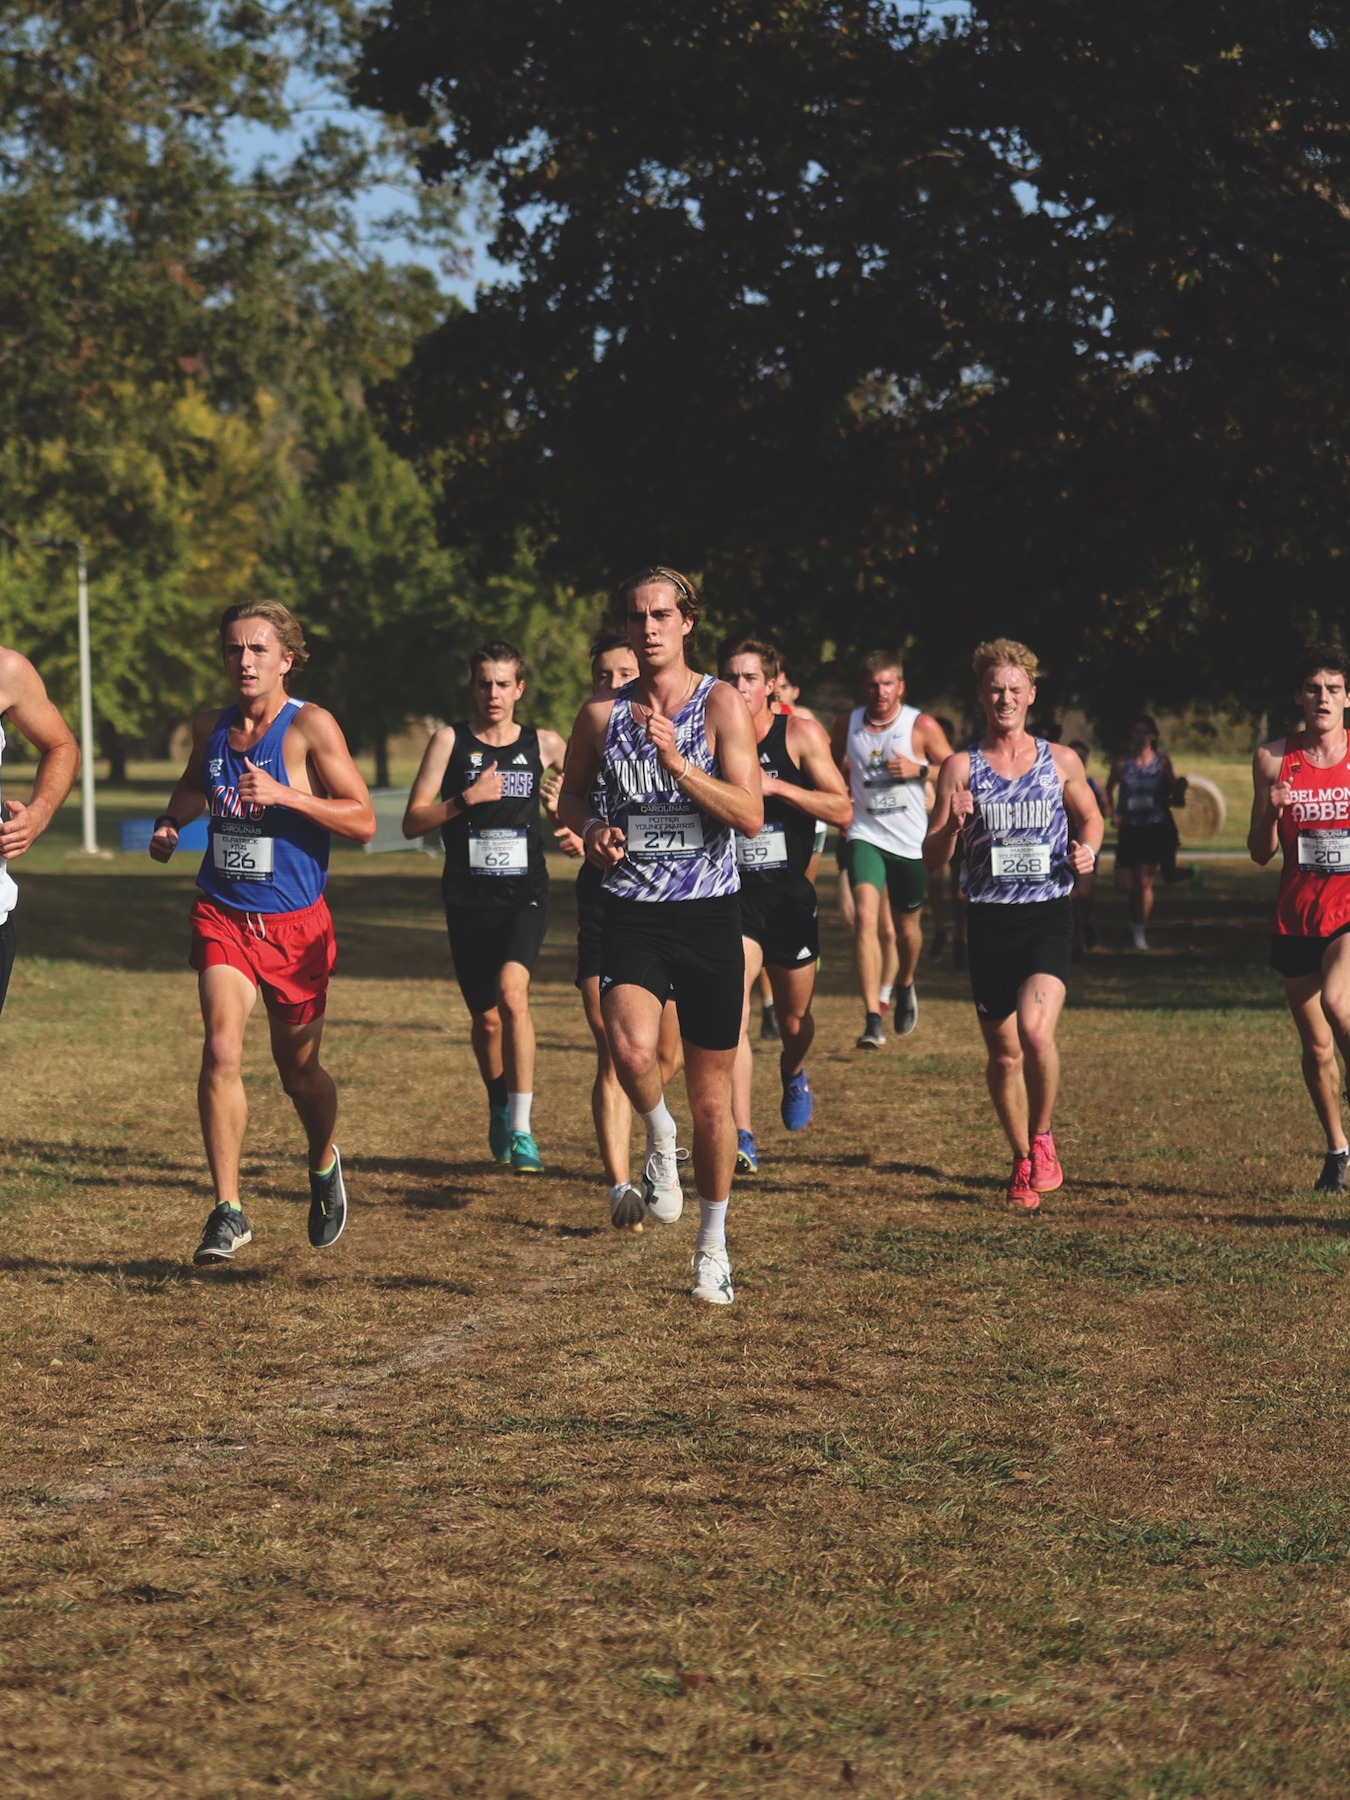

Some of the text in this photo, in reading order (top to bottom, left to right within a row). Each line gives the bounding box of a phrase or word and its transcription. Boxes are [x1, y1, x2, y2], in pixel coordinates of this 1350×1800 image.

[614, 760, 653, 794] YOUNG
[873, 796, 897, 807] 143
[640, 805, 689, 813] CAROLINAS
[980, 799, 1052, 830] YOUNG HARRIS
[1291, 801, 1350, 822] ABBE
[221, 823, 262, 834] CAROLINAS
[644, 831, 685, 849] 271
[222, 850, 255, 869] 126
[485, 852, 510, 866] 62
[742, 847, 768, 862] 59
[1314, 850, 1341, 864] 20
[1002, 859, 1042, 873] 268
